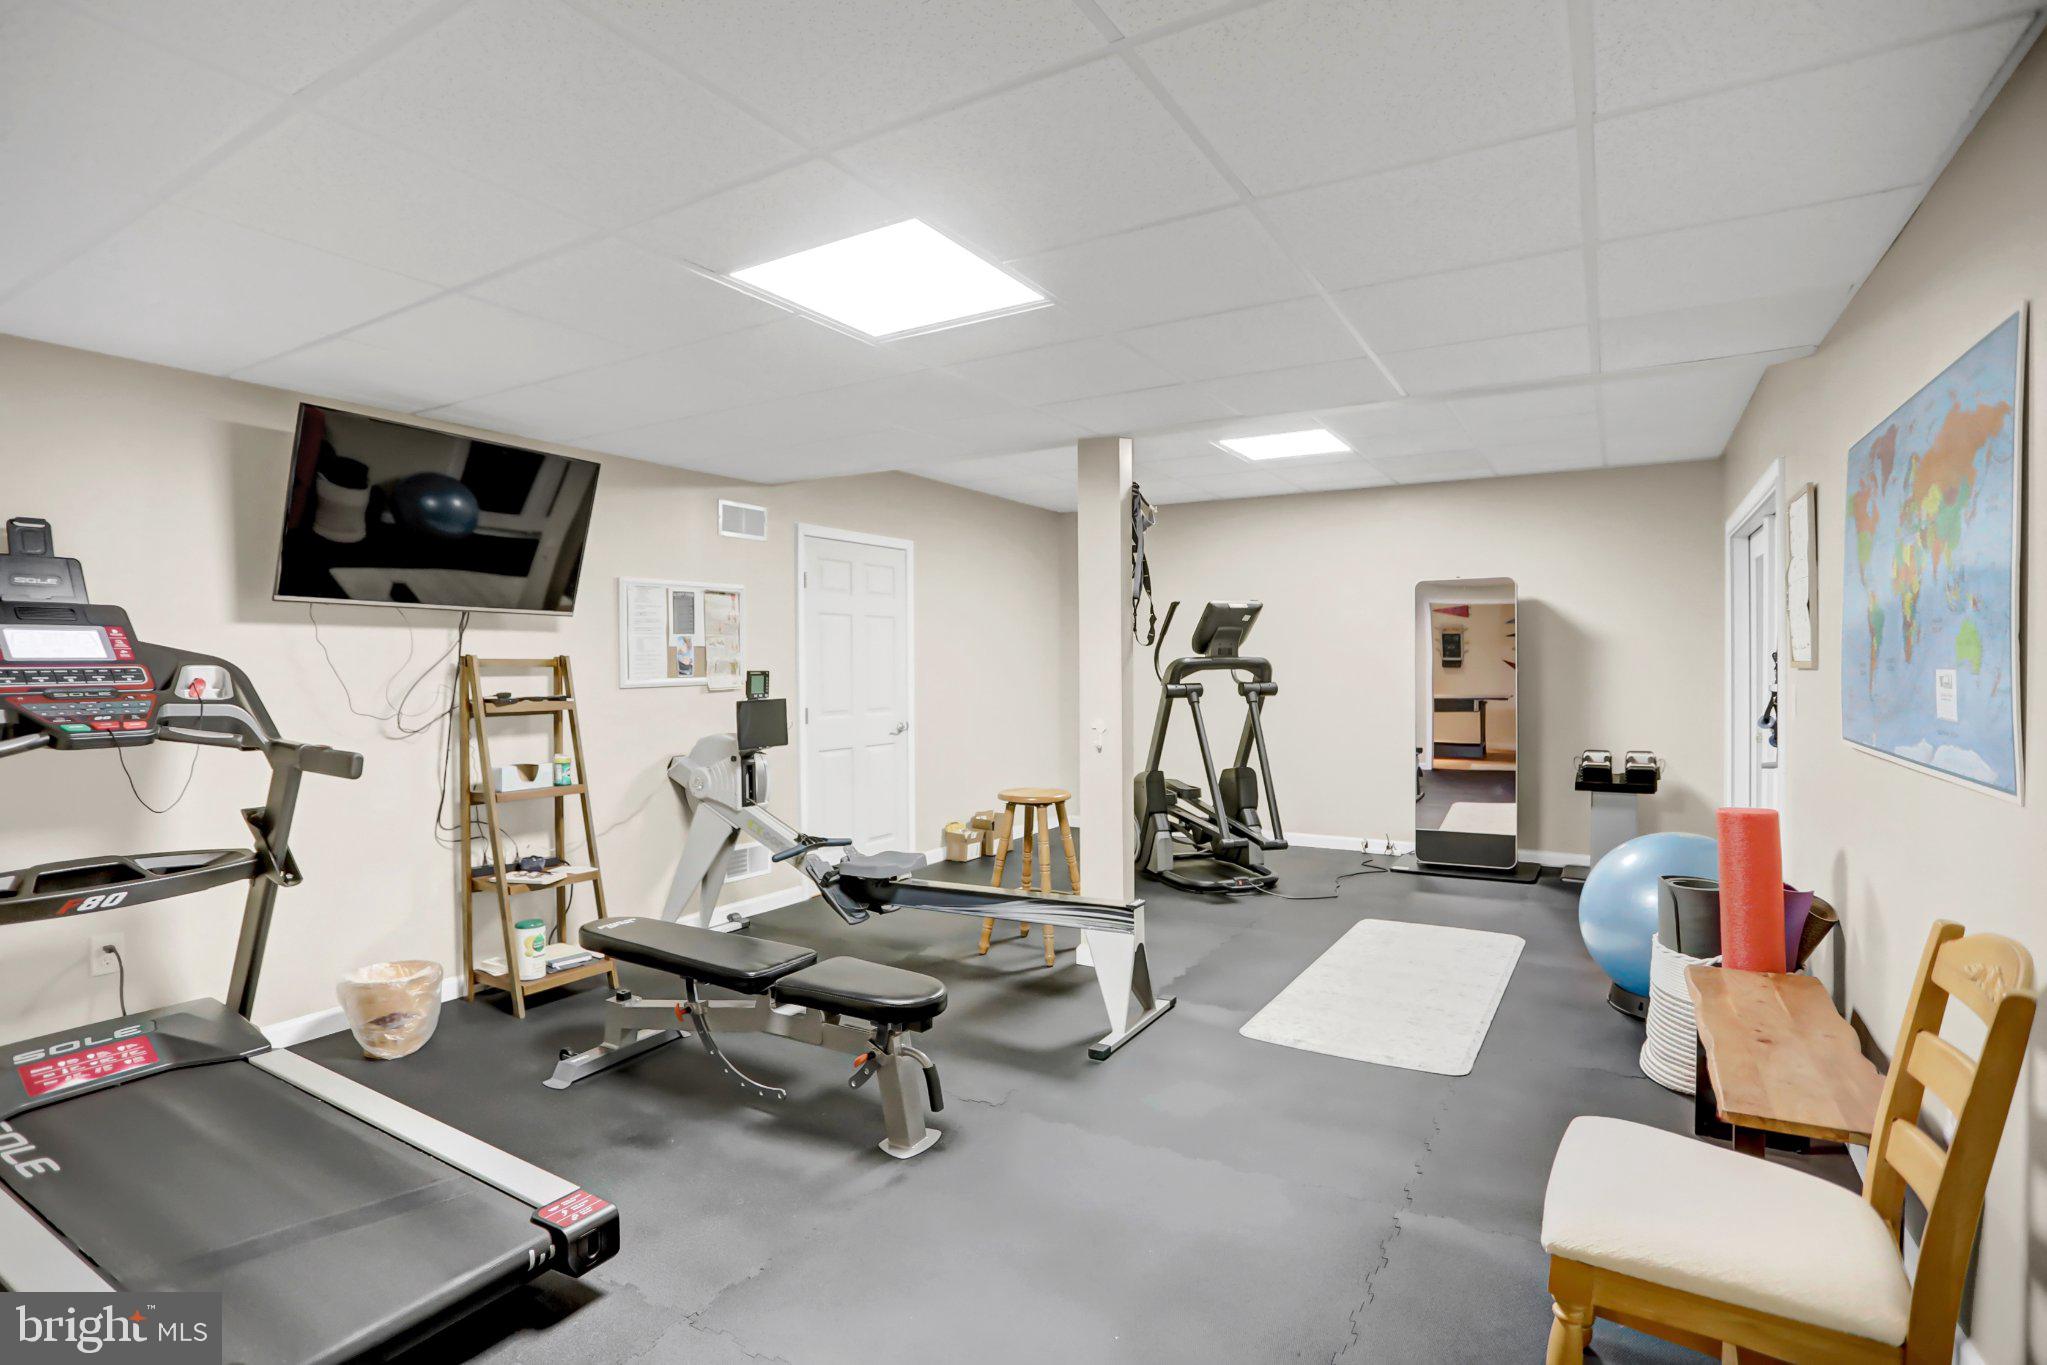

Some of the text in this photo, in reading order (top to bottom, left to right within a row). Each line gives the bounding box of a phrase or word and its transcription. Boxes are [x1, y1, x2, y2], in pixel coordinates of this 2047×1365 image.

[13, 576, 58, 585] SOLE
[56, 891, 129, 916] F80
[12, 1024, 143, 1066] SOLE
[0, 1121, 61, 1178] OLE
